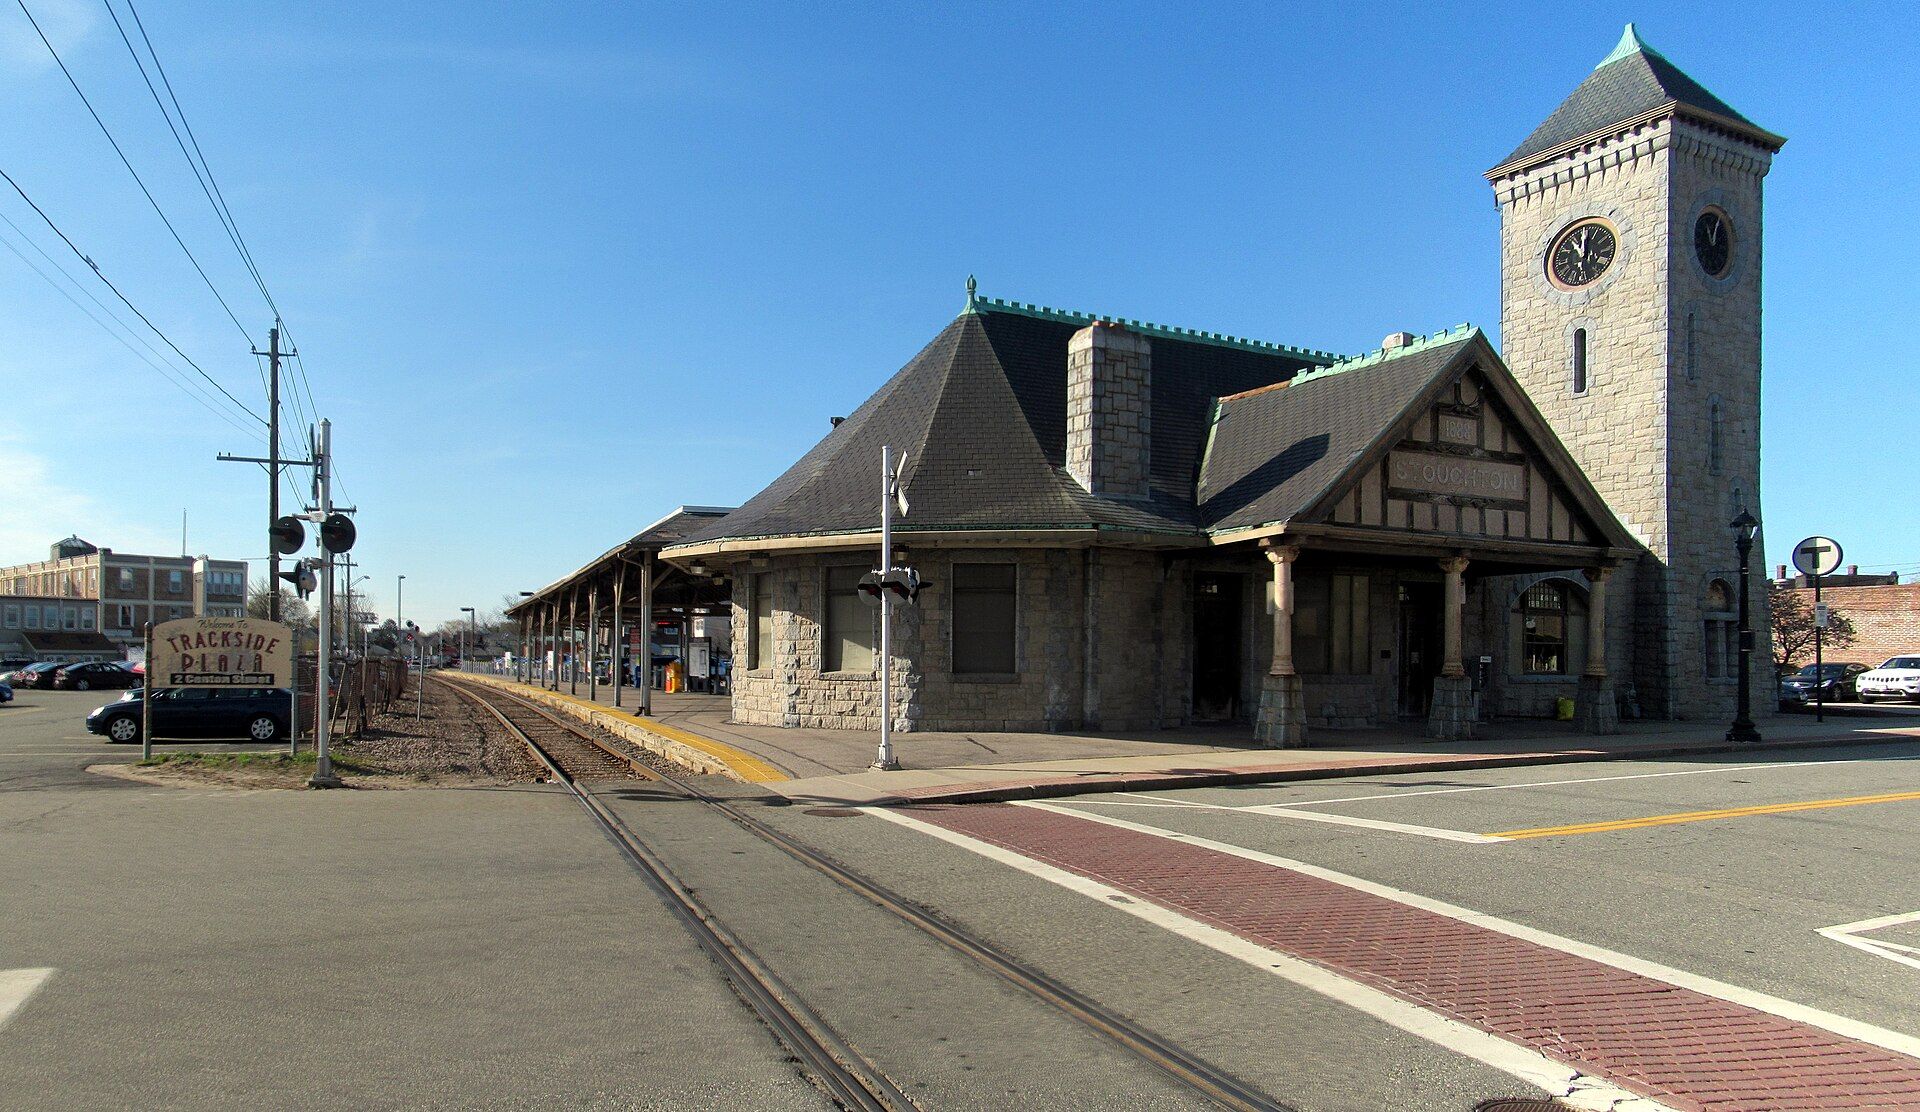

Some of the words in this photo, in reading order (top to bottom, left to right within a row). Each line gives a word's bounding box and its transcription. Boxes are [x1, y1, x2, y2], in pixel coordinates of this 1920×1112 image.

[1395, 460, 1519, 490] STOUGHTON
[1801, 546, 1831, 568] T
[198, 618, 234, 629] Welcome
[237, 620, 248, 629] To
[167, 631, 280, 654] TRACKSIDE
[182, 654, 262, 672] PLAZA
[174, 674, 183, 684] 2
